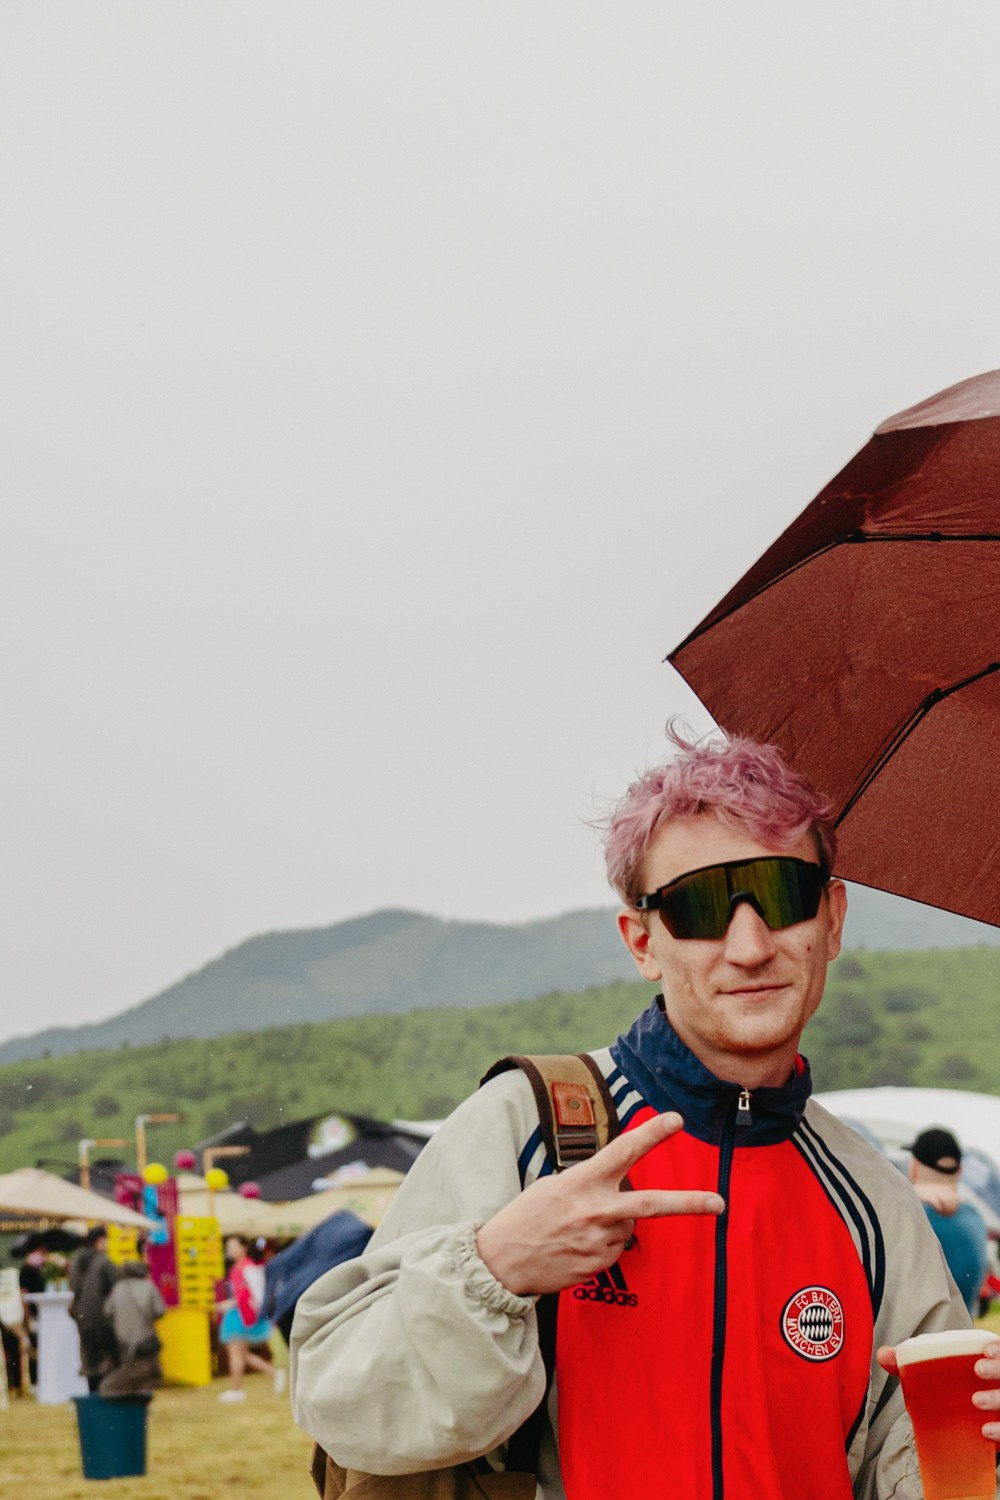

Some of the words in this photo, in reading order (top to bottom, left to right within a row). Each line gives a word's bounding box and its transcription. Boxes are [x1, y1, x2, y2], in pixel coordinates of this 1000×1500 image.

[573, 1285, 638, 1307] adidas
[794, 1294, 809, 1310] FC
[811, 1291, 842, 1324] BAYERN
